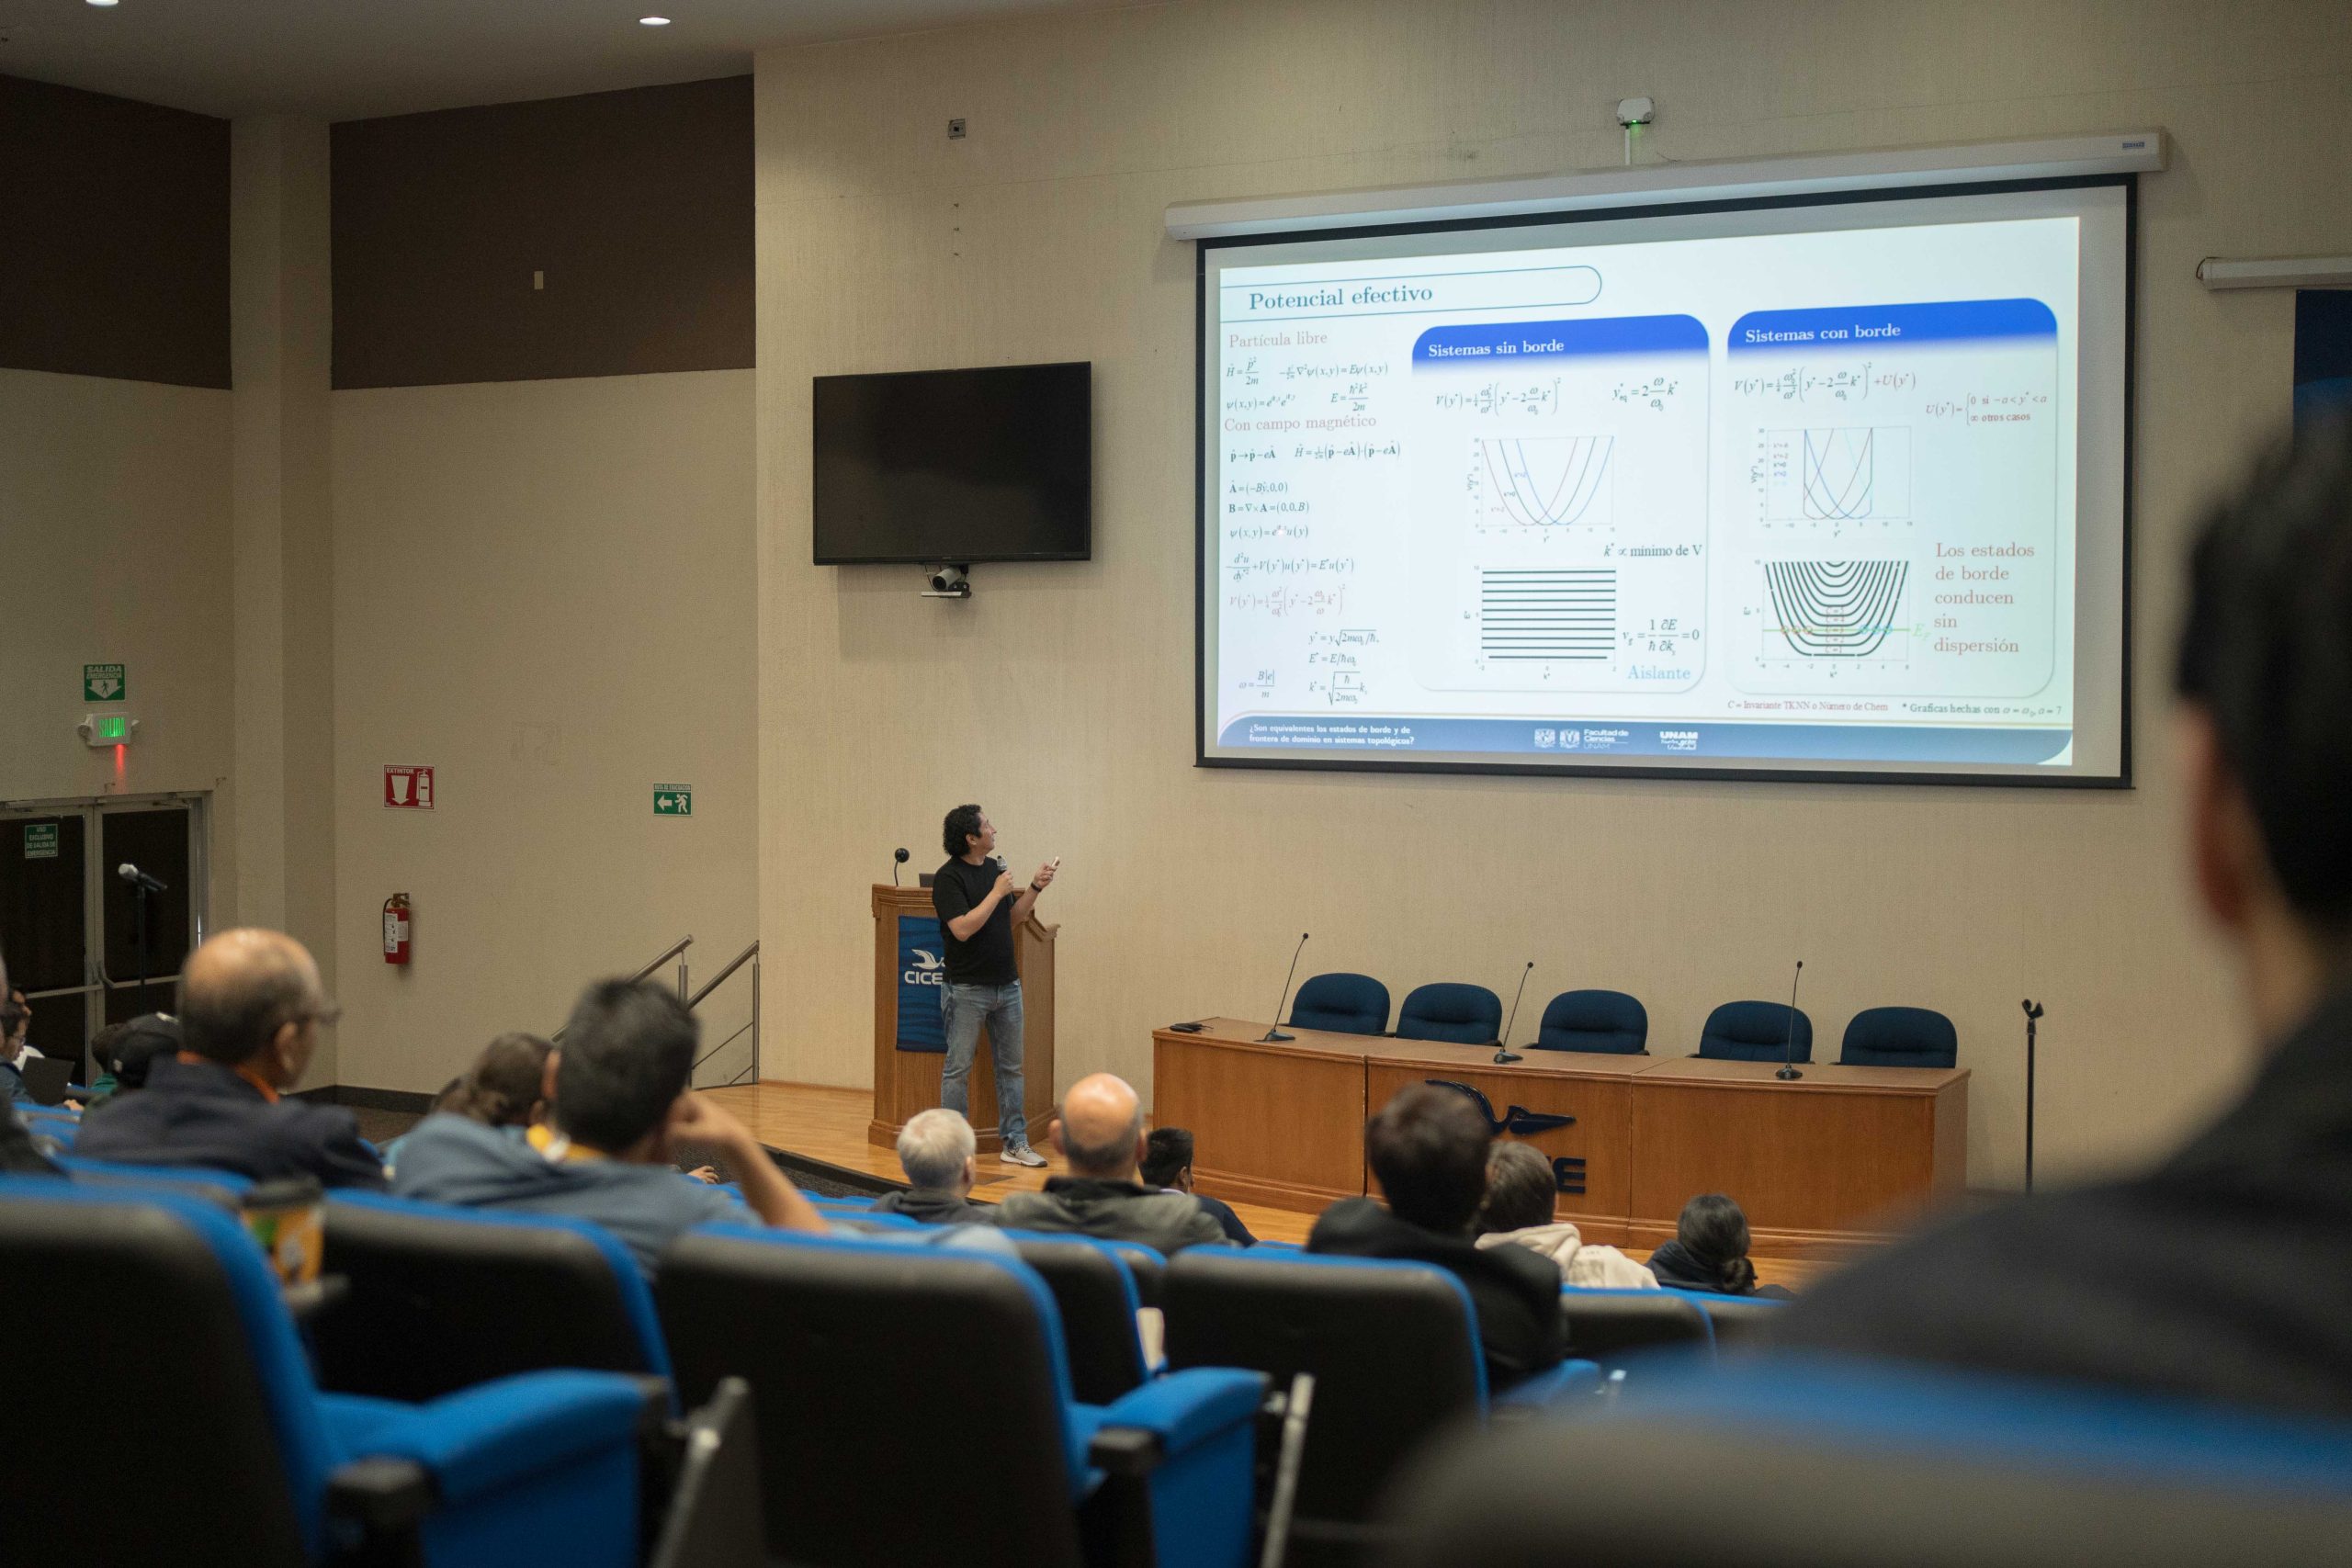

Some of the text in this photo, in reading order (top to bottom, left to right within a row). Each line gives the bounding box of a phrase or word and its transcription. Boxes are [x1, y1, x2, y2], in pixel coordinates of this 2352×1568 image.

[1250, 285, 1432, 310] Potencial efectivo
[1229, 331, 1328, 348] Partícula libre
[1746, 323, 1901, 343] Sistemas con borde
[1429, 339, 1565, 357] Sistemas sin borde
[1224, 413, 1376, 433] Con campo magnético
[1981, 413, 2004, 422] otros
[2006, 413, 2030, 422] casos
[1675, 544, 1689, 556] de
[1691, 544, 1702, 556] V
[1936, 541, 2035, 558] Los estados
[1935, 565, 2009, 581] de borde
[1934, 589, 2014, 604] conducen
[1934, 613, 1957, 628] sin
[1933, 637, 2019, 656] dispersión
[86, 665, 122, 673] SALIDA
[1627, 665, 1691, 680] Aislante
[1744, 700, 1781, 709] Invariante
[1853, 703, 1863, 711] de
[1950, 704, 1981, 714] hechas
[98, 717, 126, 738] SALIDA
[1250, 724, 1267, 733] ¿Son
[1270, 725, 1315, 734] equivalentes
[1317, 725, 1327, 733] los
[1370, 726, 1392, 734] borde
[1401, 726, 1411, 734] de
[1659, 731, 1699, 739] UNAM
[1250, 735, 1278, 743] frontera
[1280, 735, 1290, 743] de
[1292, 736, 1321, 744] dominio
[1335, 736, 1365, 745] sistemas
[1368, 736, 1415, 747] topológicos?
[904, 970, 944, 986] CICE
